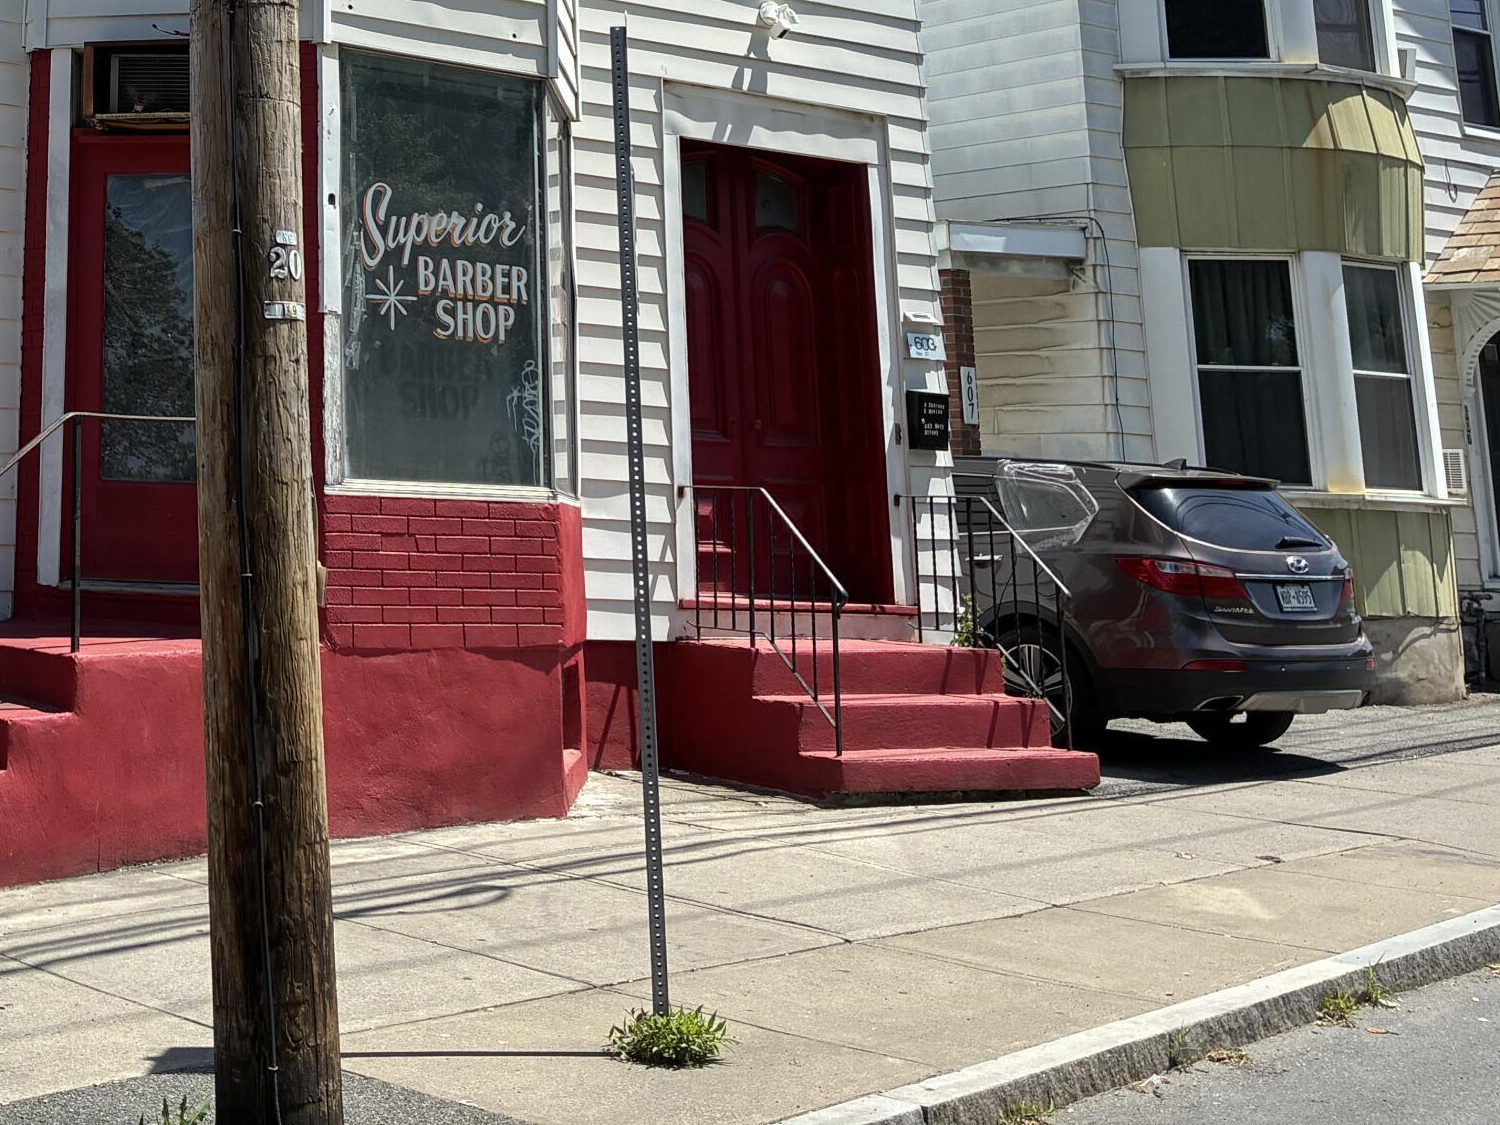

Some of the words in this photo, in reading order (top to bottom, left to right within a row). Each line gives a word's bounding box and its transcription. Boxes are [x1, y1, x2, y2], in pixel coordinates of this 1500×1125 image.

[361, 182, 525, 270] Superior
[269, 246, 301, 280] 20
[416, 255, 528, 305] BARBER
[434, 299, 516, 345] SHOP
[966, 371, 975, 420] 607
